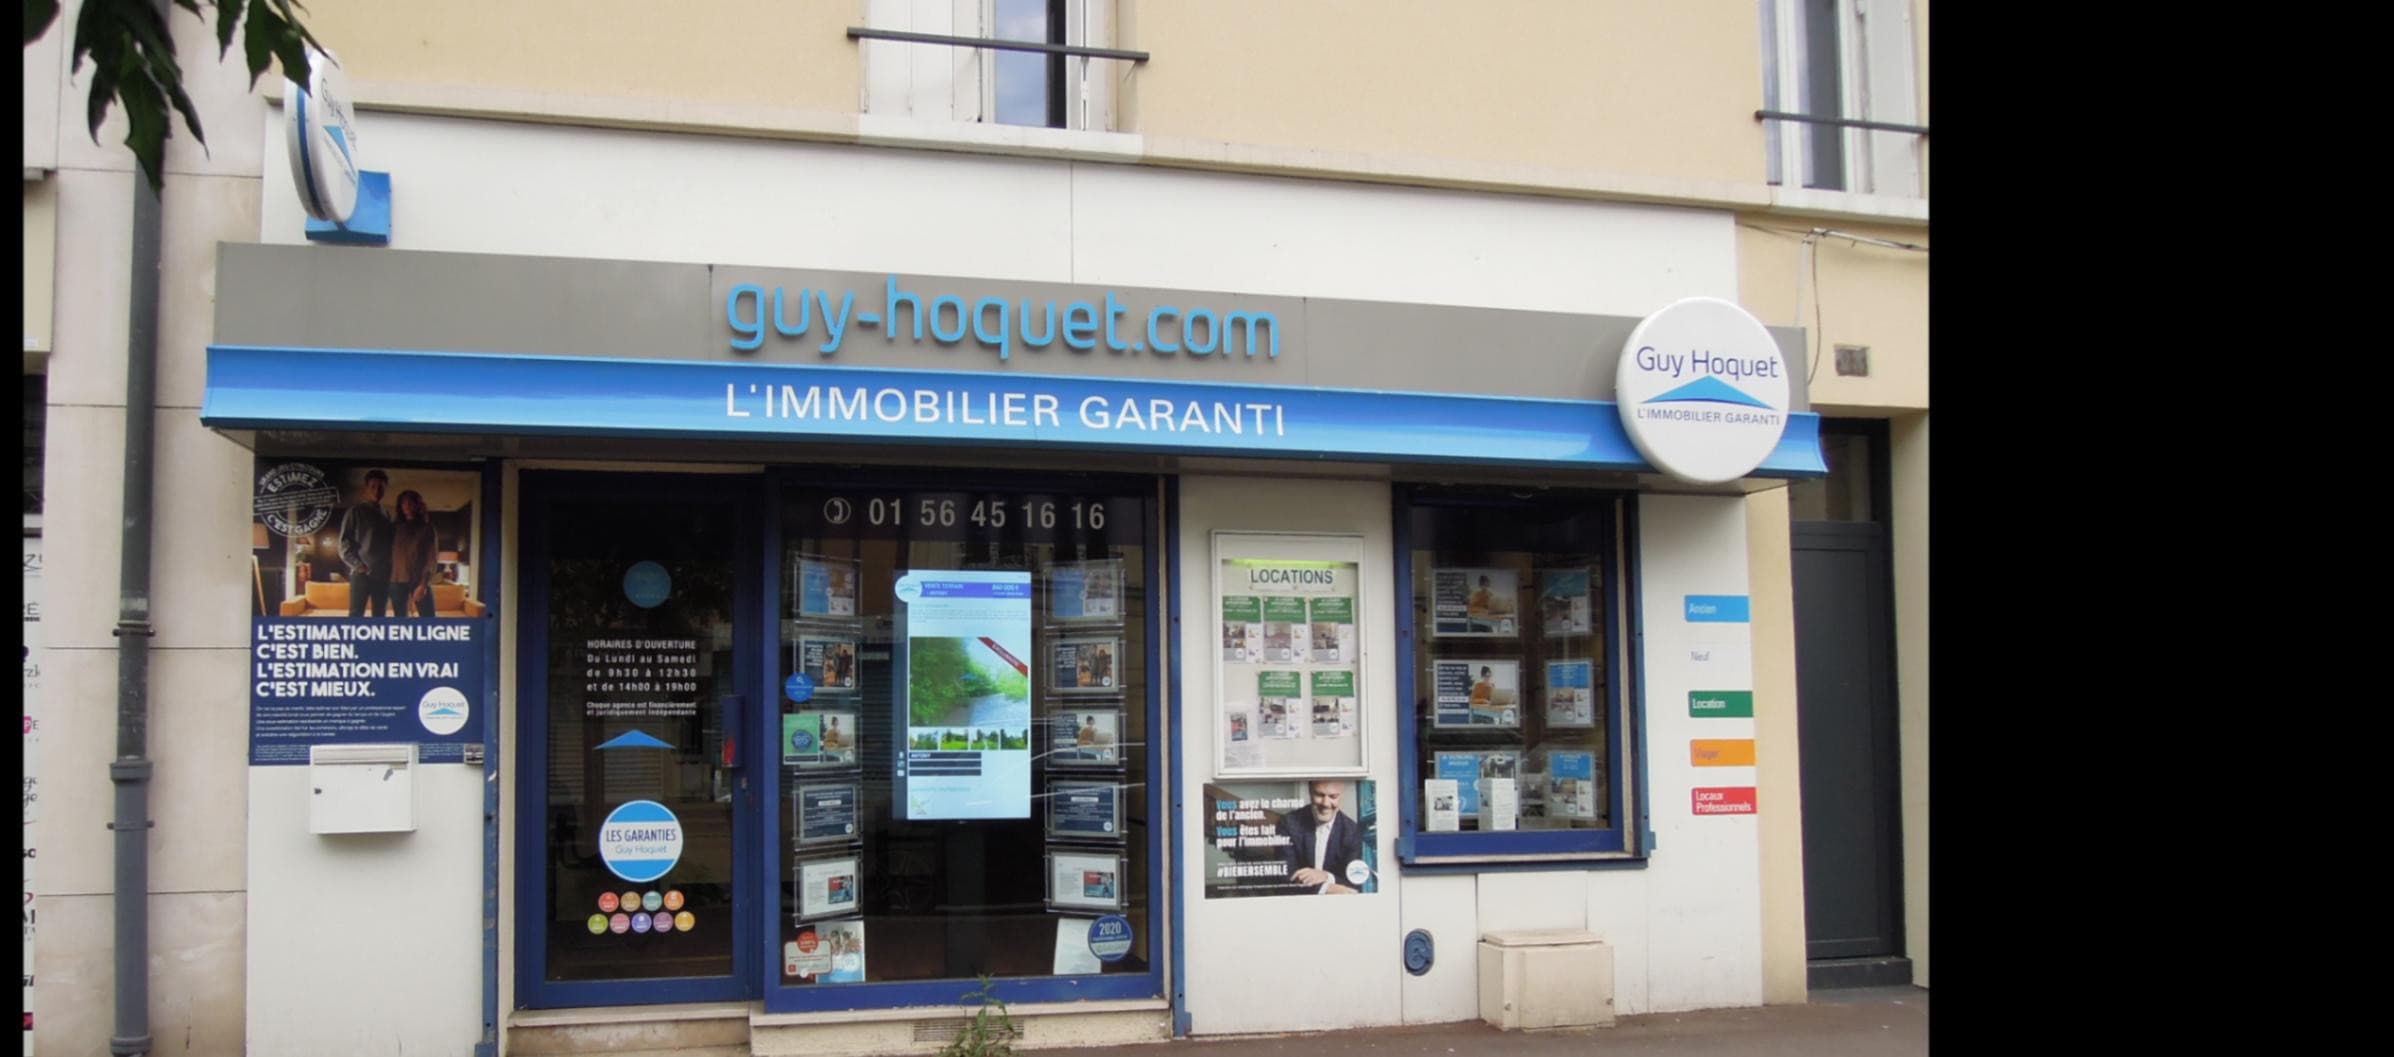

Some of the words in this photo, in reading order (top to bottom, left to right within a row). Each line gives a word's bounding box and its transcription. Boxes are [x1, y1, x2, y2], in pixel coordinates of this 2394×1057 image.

[725, 273, 1280, 360] guy-hoquet.com
[1636, 345, 1684, 378] Guy
[1691, 349, 1779, 381] Hoquet
[726, 382, 1060, 427] L'IMMOBILIER
[1079, 394, 1285, 437] GARANTI
[1637, 407, 1722, 423] L'IMMOBILIER
[1724, 411, 1781, 426] GARANTI
[868, 498, 901, 526] 01
[919, 499, 956, 527] 56
[970, 500, 1007, 528] 45
[1021, 502, 1056, 529] 16
[1070, 503, 1106, 530] 16
[1250, 568, 1334, 585] LOCATIONS
[257, 624, 385, 641] L'ESTIMATION
[388, 625, 414, 641] EN
[416, 625, 471, 641] LIGNE
[256, 643, 309, 660] C'EST
[312, 644, 359, 660] BIEN.
[587, 639, 632, 649] HORAIRES
[635, 639, 697, 649] D'OUVERTURE
[587, 654, 600, 664] Du
[605, 654, 635, 664] Lundi
[640, 655, 653, 664] au
[657, 654, 696, 664] Samedi
[256, 662, 384, 679] L'ESTIMATION
[388, 663, 413, 679] EN
[415, 663, 459, 679] VRAI
[586, 668, 600, 678] de
[659, 668, 697, 678] 12h30
[255, 681, 308, 697] C'EST
[311, 681, 376, 697] MIEUX.
[586, 682, 597, 692] et
[601, 682, 614, 692] de
[619, 682, 651, 692] 14h00
[665, 682, 697, 692] 19h00
[1692, 698, 1726, 710] Location
[1695, 790, 1724, 801] Locaux
[606, 830, 622, 843] LES
[624, 828, 677, 842] GARANTIES
[1098, 920, 1122, 937] 2020
